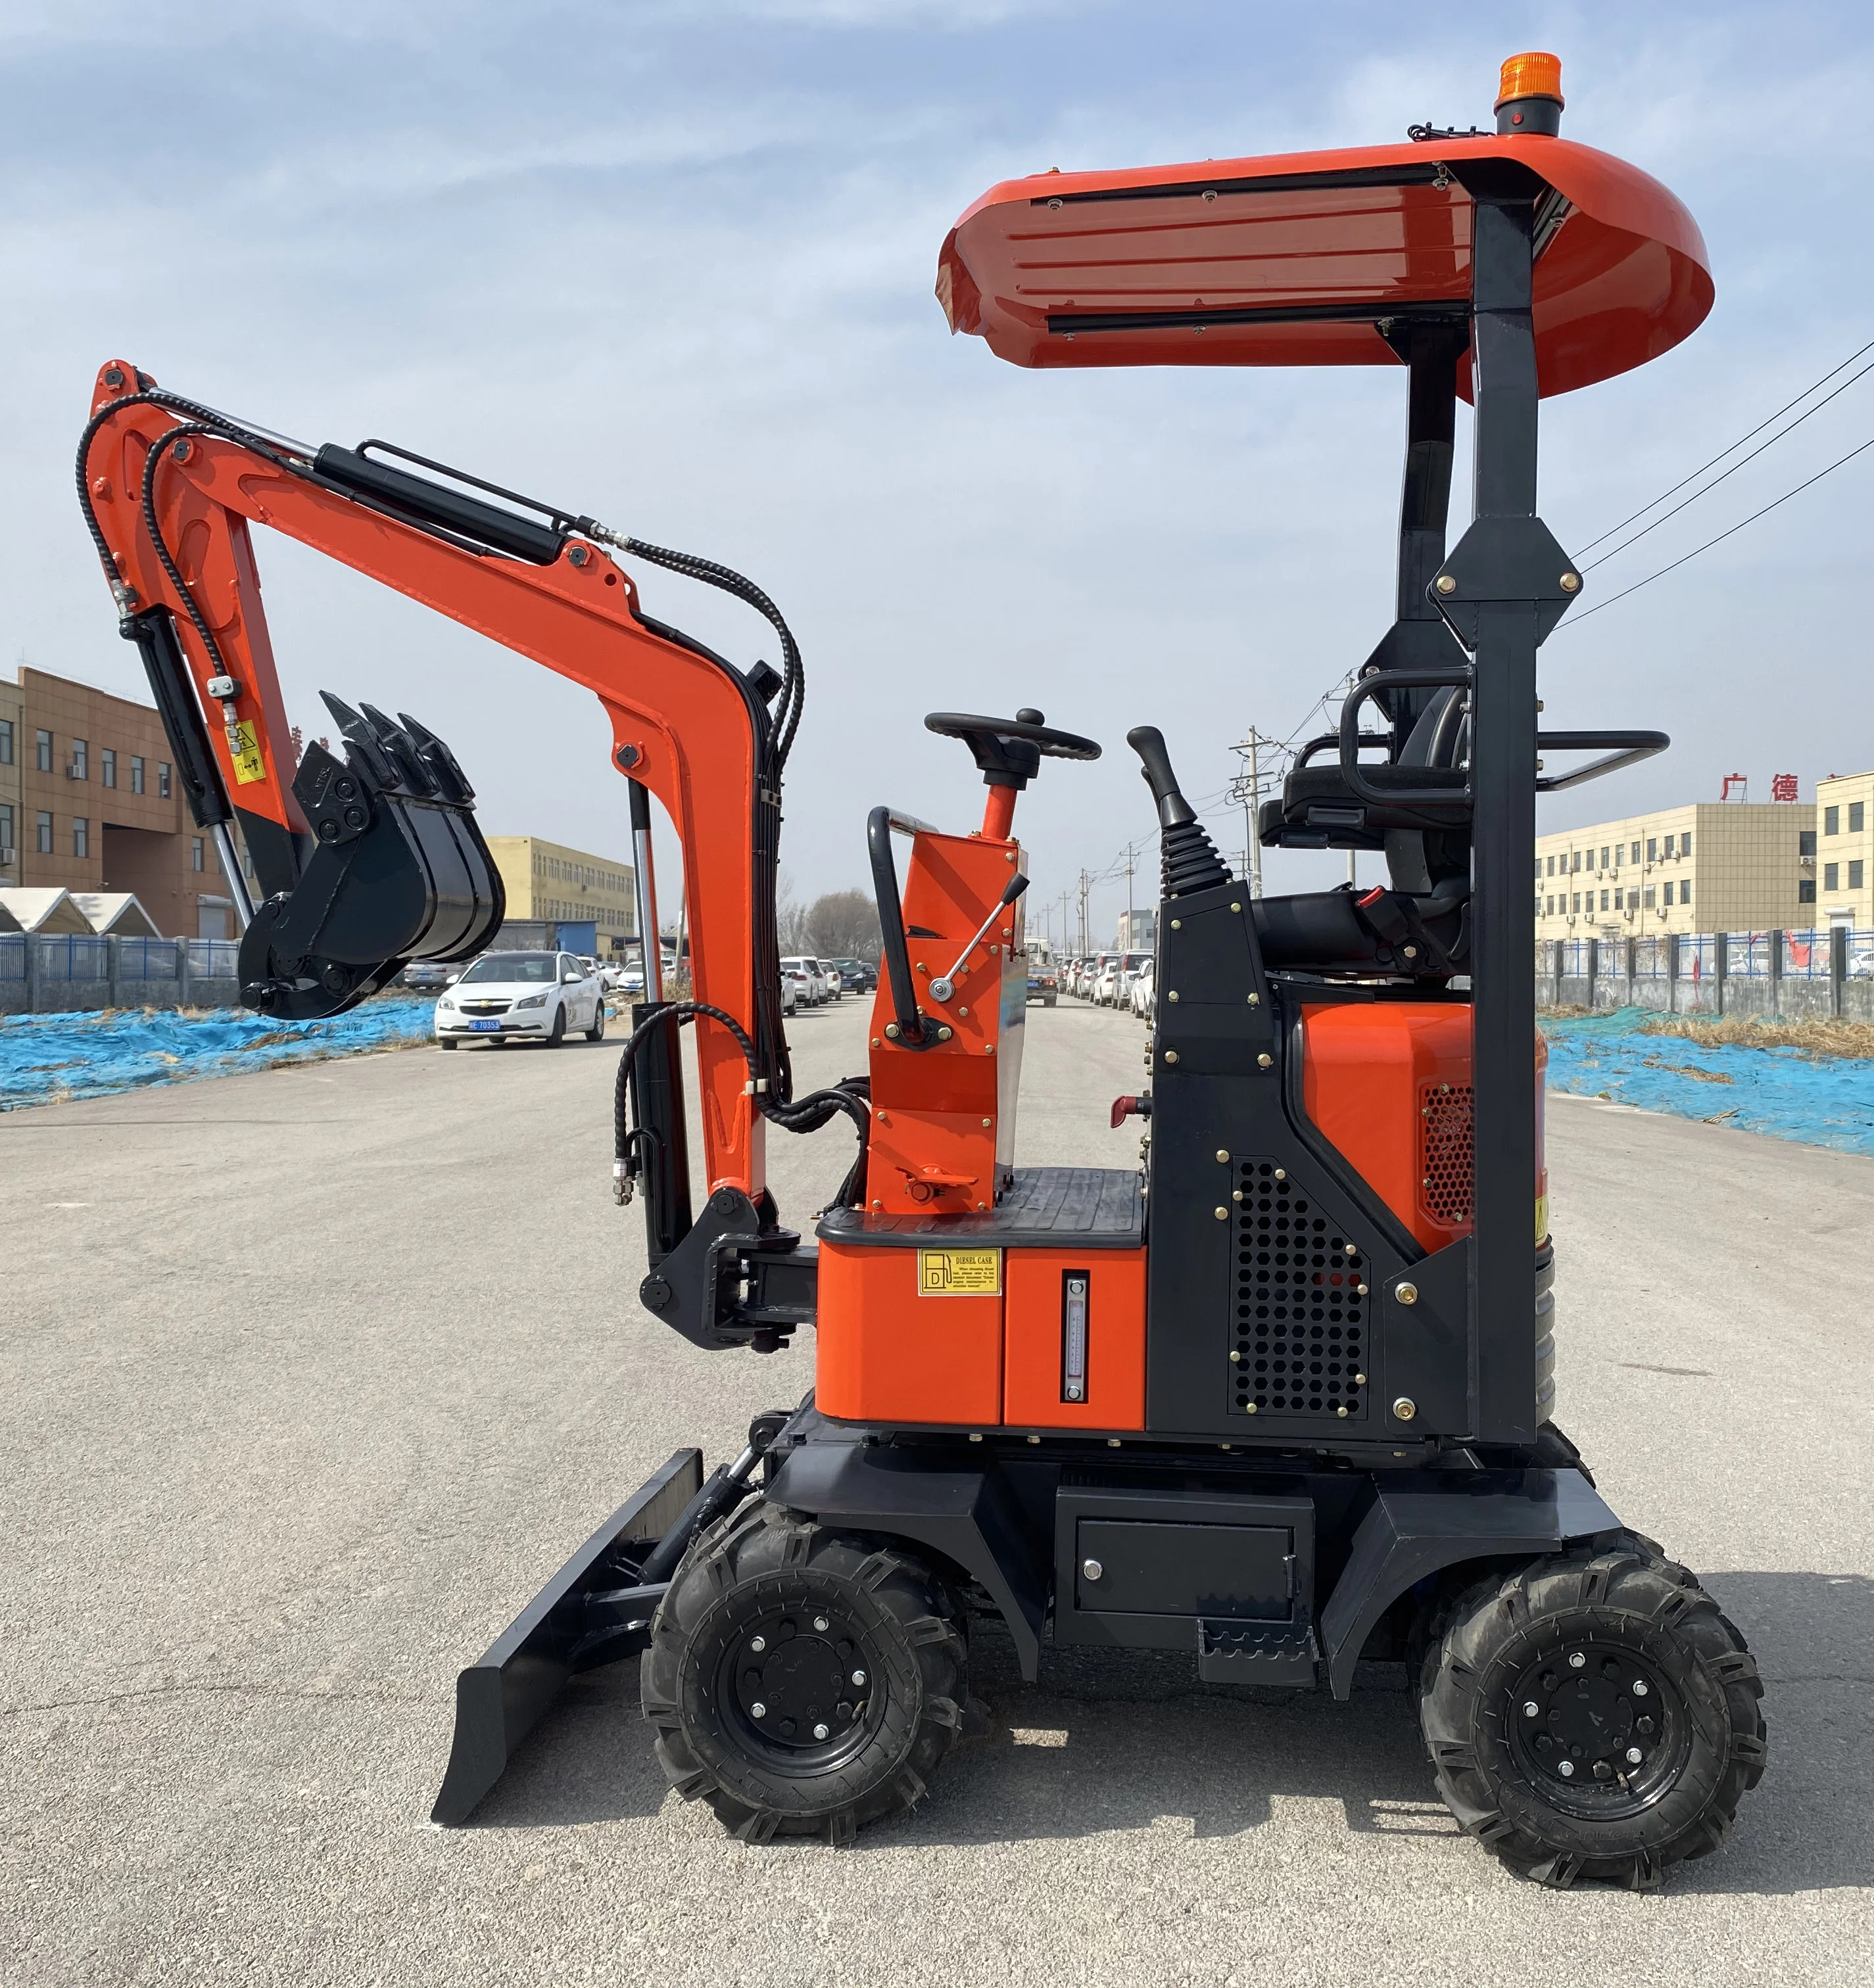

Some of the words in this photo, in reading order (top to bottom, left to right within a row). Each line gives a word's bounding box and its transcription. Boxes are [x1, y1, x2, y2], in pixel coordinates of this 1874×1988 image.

[1720, 772, 1848, 801] 广德
[480, 1021, 499, 1030] 70353
[955, 1256, 976, 1265] DIESEL
[931, 1272, 940, 1285] D
